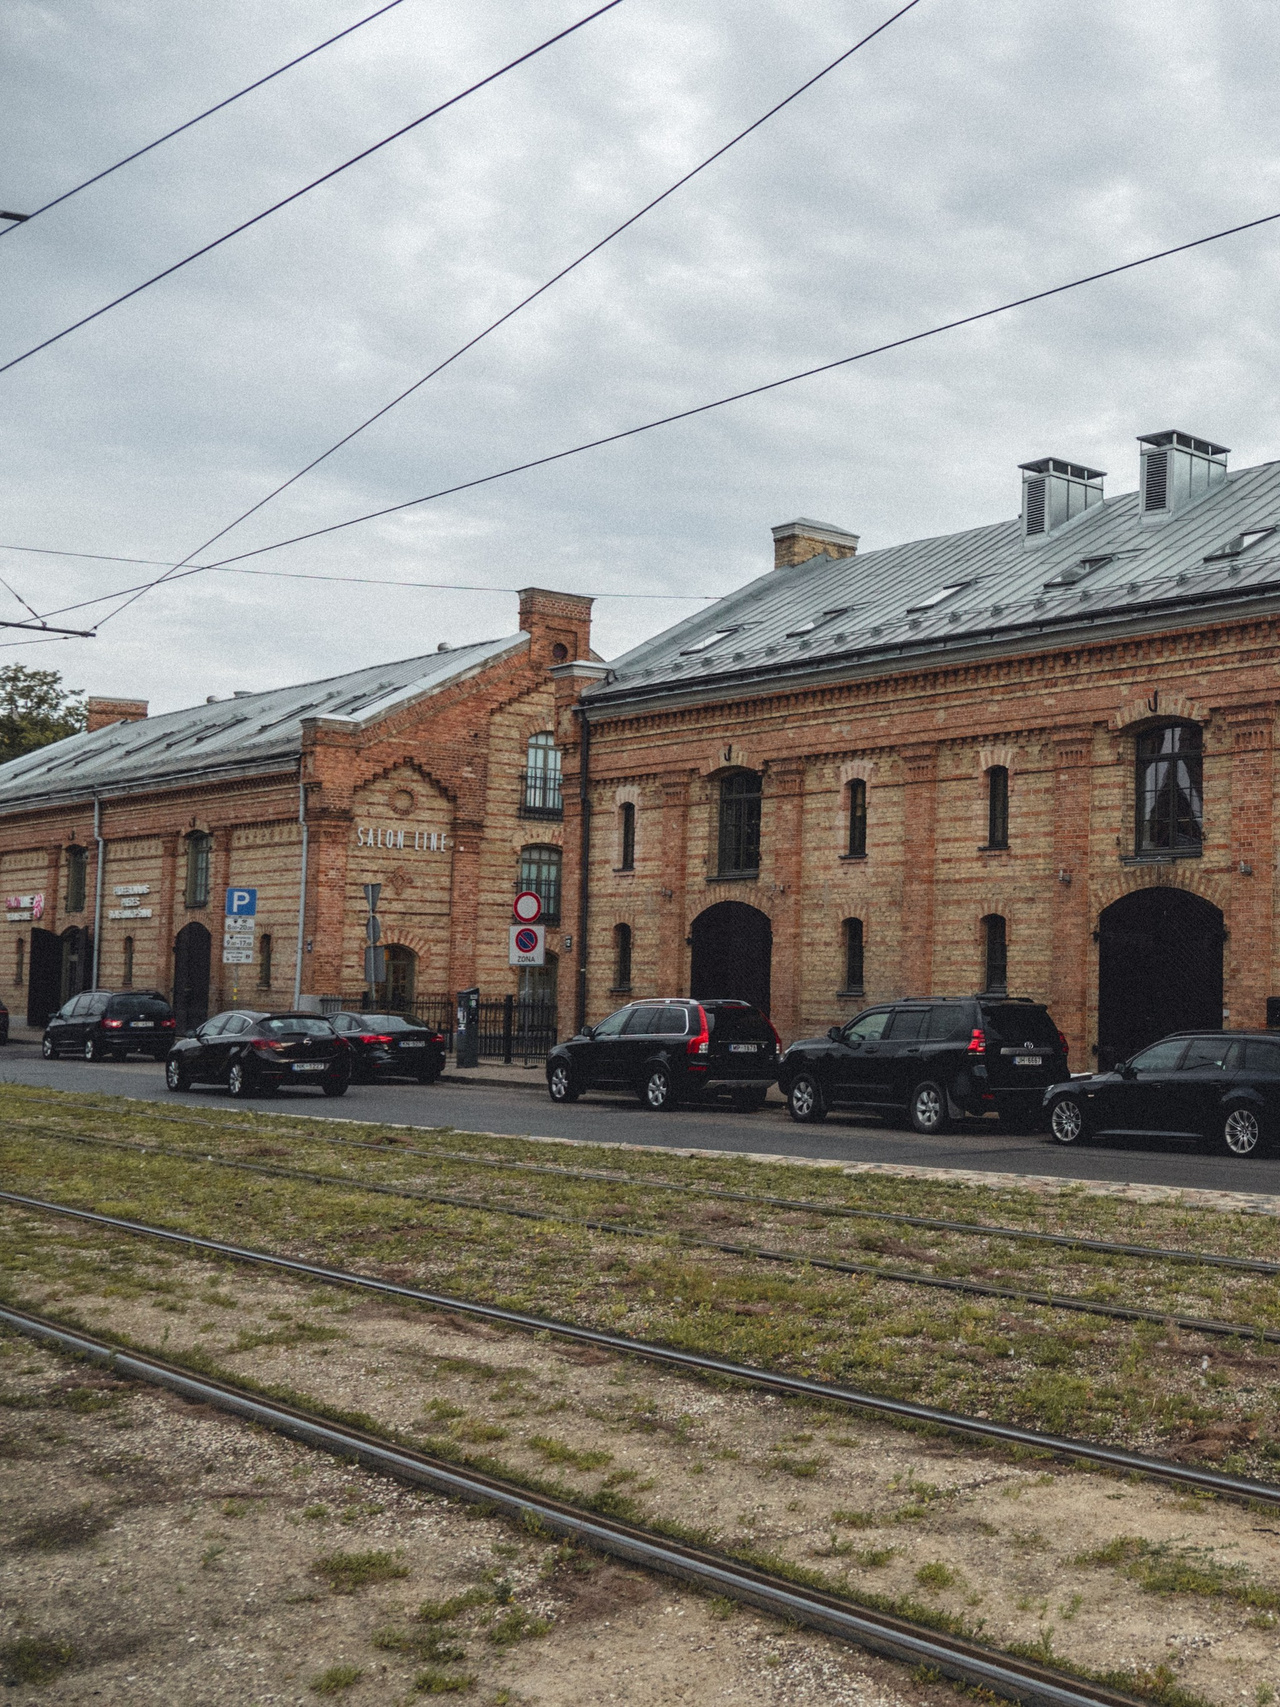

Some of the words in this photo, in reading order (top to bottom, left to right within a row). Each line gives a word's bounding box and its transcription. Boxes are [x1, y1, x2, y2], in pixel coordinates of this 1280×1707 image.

[357, 827, 404, 849] SALON
[414, 831, 447, 852] LINE
[233, 891, 250, 913] P
